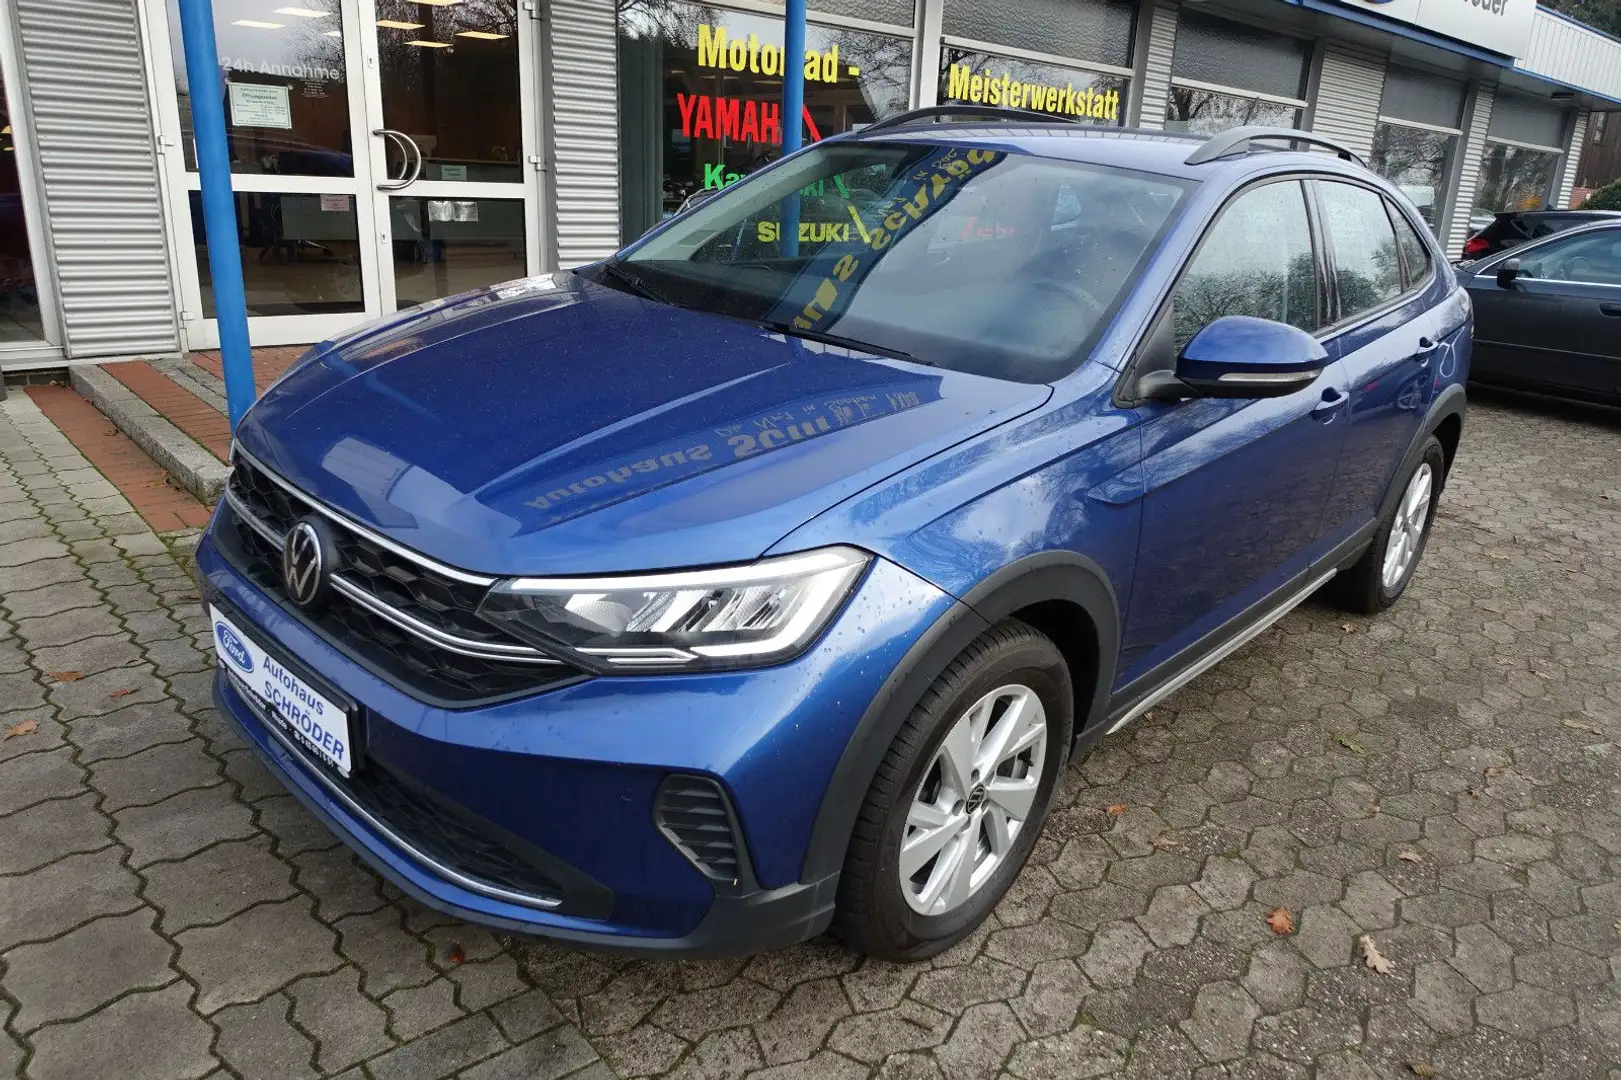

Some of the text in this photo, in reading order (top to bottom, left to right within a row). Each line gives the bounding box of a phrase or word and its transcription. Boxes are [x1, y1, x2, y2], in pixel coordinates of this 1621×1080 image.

[223, 57, 340, 81] 24h Annahme
[698, 24, 839, 83] Motoad
[949, 63, 1119, 120] Meisterwerkstatt
[677, 93, 784, 145] YAMAH
[757, 221, 849, 243] SZUKI
[223, 629, 246, 664] Ford
[263, 656, 324, 716] Autohaus
[265, 681, 345, 761] SCHRÖDER
